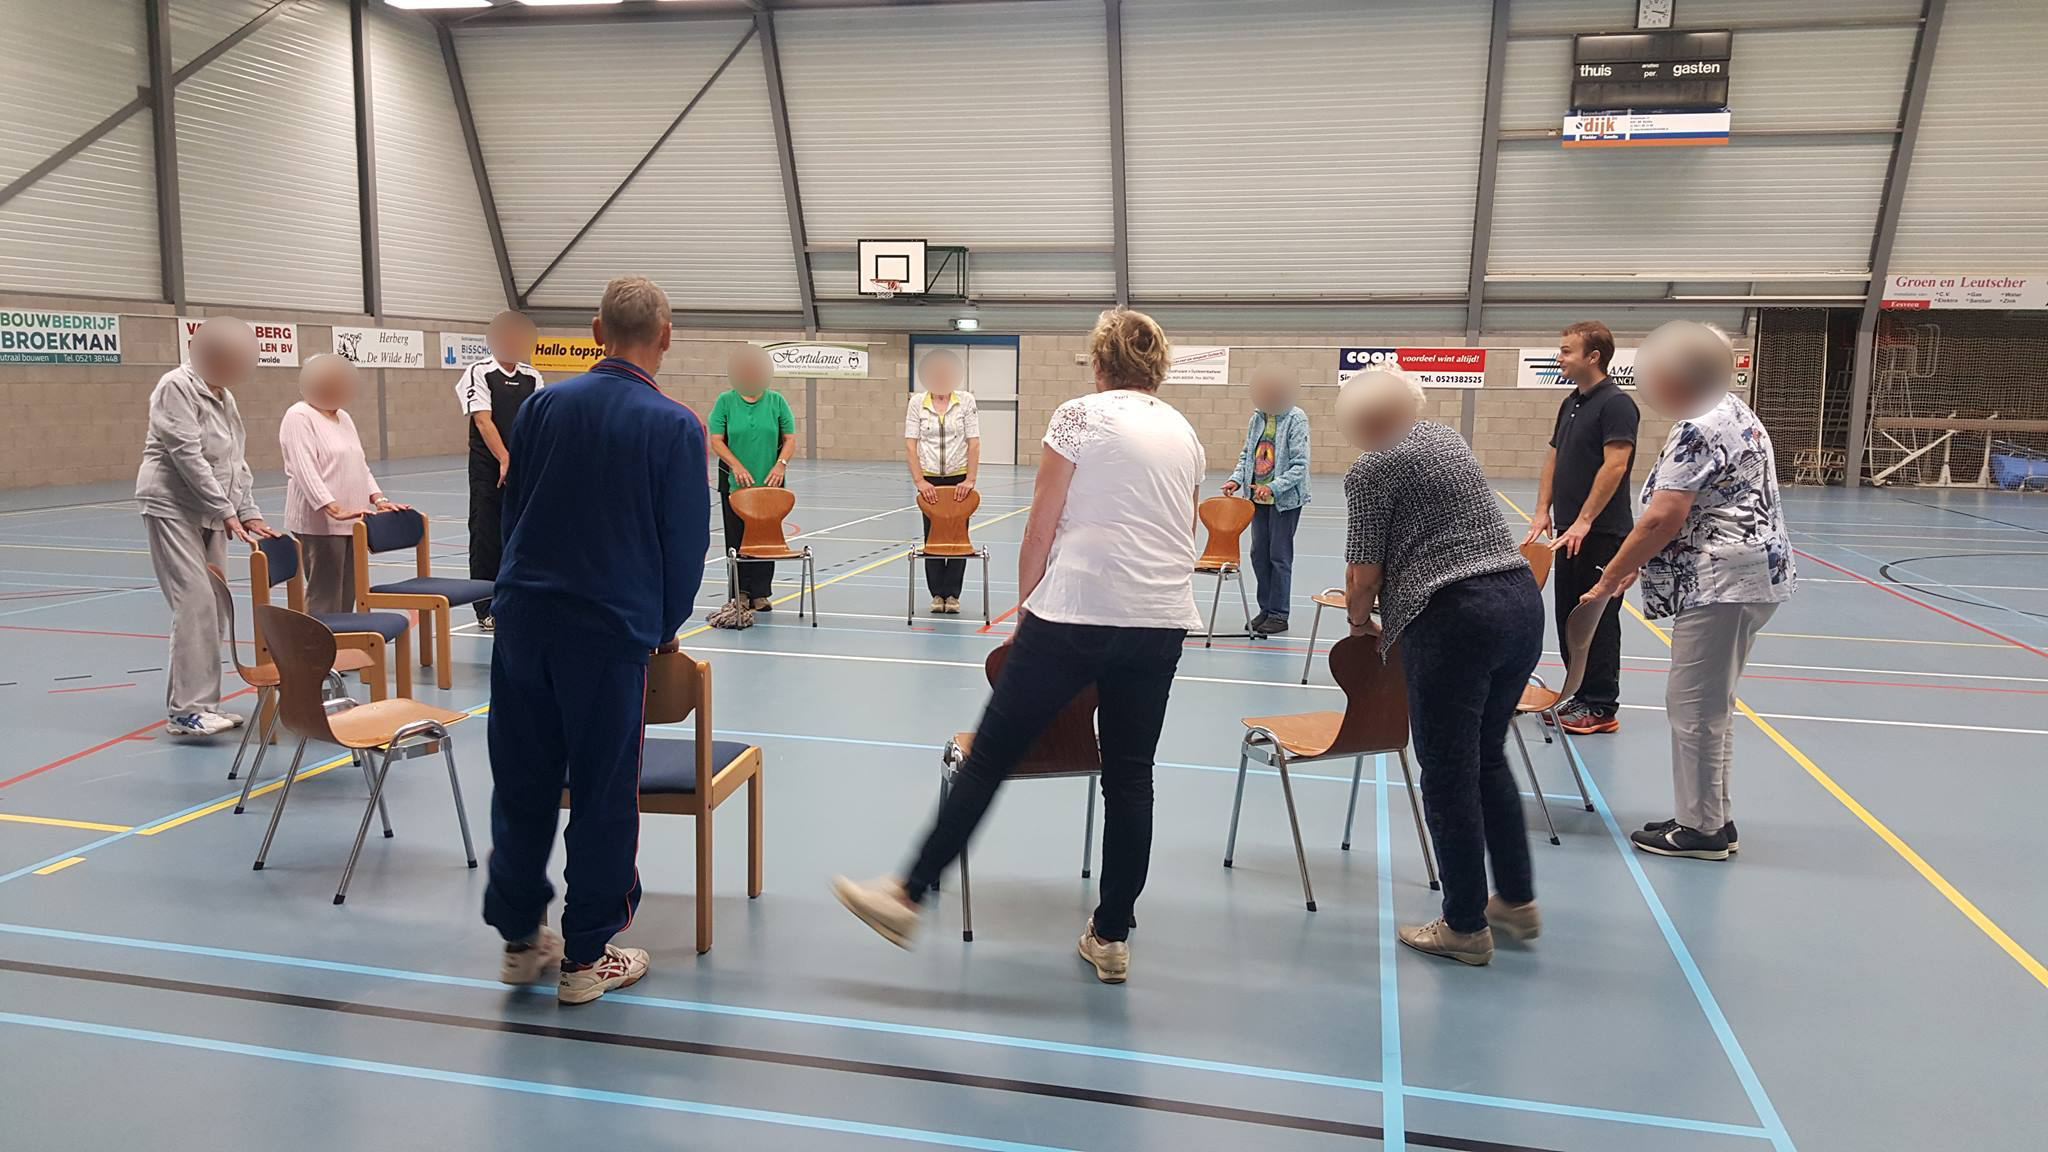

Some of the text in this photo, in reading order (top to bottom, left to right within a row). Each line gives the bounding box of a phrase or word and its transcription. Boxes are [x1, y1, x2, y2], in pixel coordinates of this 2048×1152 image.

[1579, 64, 1612, 77] thuis
[1672, 61, 1721, 78] gasten
[1584, 117, 1615, 136] dijk
[1895, 276, 2027, 288] Groen en Leutscher
[0, 312, 116, 330] BOUWBEDRIJF
[255, 326, 292, 339] BERG
[1, 331, 117, 351] BROEKMAN
[379, 332, 409, 346] Herberg
[260, 343, 293, 353] LEN BV
[461, 344, 492, 355] BISSCHO
[535, 344, 567, 356] Hallo
[0, 354, 20, 362] utraal
[21, 354, 49, 362] bouwen
[93, 355, 119, 363] 381448
[258, 356, 280, 364] rwolde
[381, 352, 402, 363] Wilde
[772, 348, 843, 365] Hortulanus
[1402, 354, 1436, 363] voordeel
[1437, 354, 1455, 363] wint
[1456, 354, 1480, 364] altijd!
[1420, 375, 1482, 383] Tel. 0521382525
